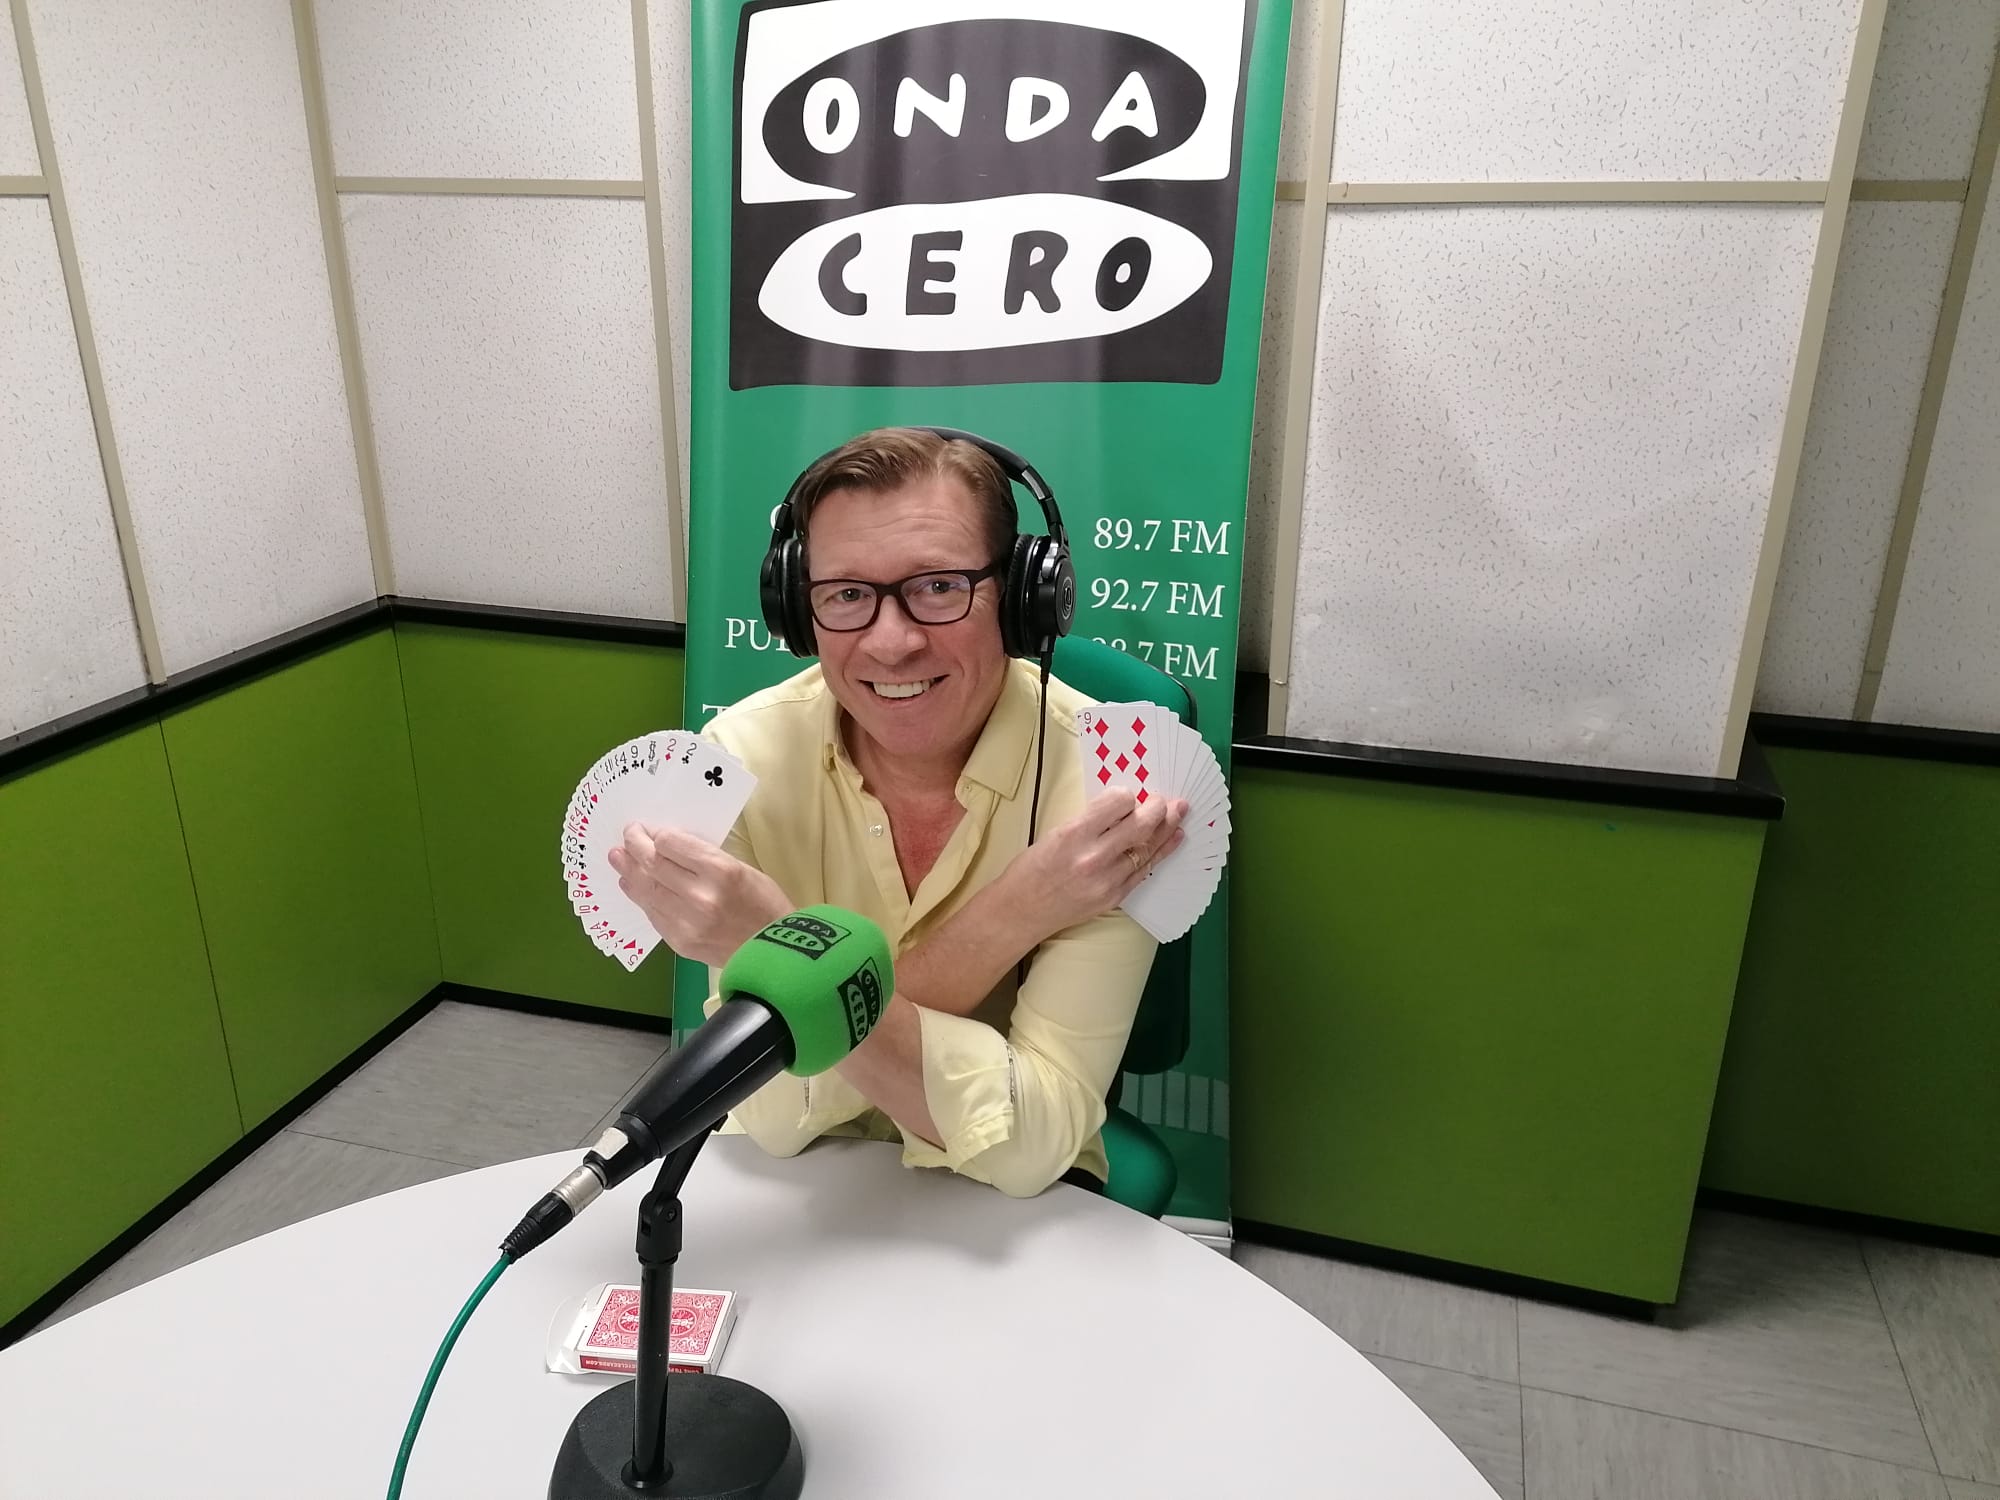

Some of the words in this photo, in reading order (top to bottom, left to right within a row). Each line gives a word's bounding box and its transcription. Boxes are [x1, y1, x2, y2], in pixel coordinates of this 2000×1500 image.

[802, 71, 1159, 154] ONDA
[818, 230, 1152, 316] CERO
[1094, 517, 1161, 551] 89.7
[1170, 519, 1231, 555] FM
[1091, 577, 1159, 612] 92.7
[1166, 581, 1225, 618] FM
[724, 617, 790, 651] PU
[1163, 642, 1219, 680] FM
[1083, 711, 1092, 725] 9
[630, 745, 639, 759] 9
[666, 738, 677, 753] 2
[686, 742, 698, 757] 2
[619, 751, 627, 764] 4
[583, 782, 592, 795] 7
[566, 835, 578, 846] 3
[568, 870, 580, 880] 3
[579, 905, 591, 914] 10
[589, 922, 601, 930] A
[786, 918, 831, 936] ONDA
[596, 932, 609, 940] J
[772, 928, 818, 948] CERO
[627, 954, 639, 966] 5
[850, 990, 866, 1036] CERO
[585, 1359, 637, 1369] CYCLECARDS.COM
